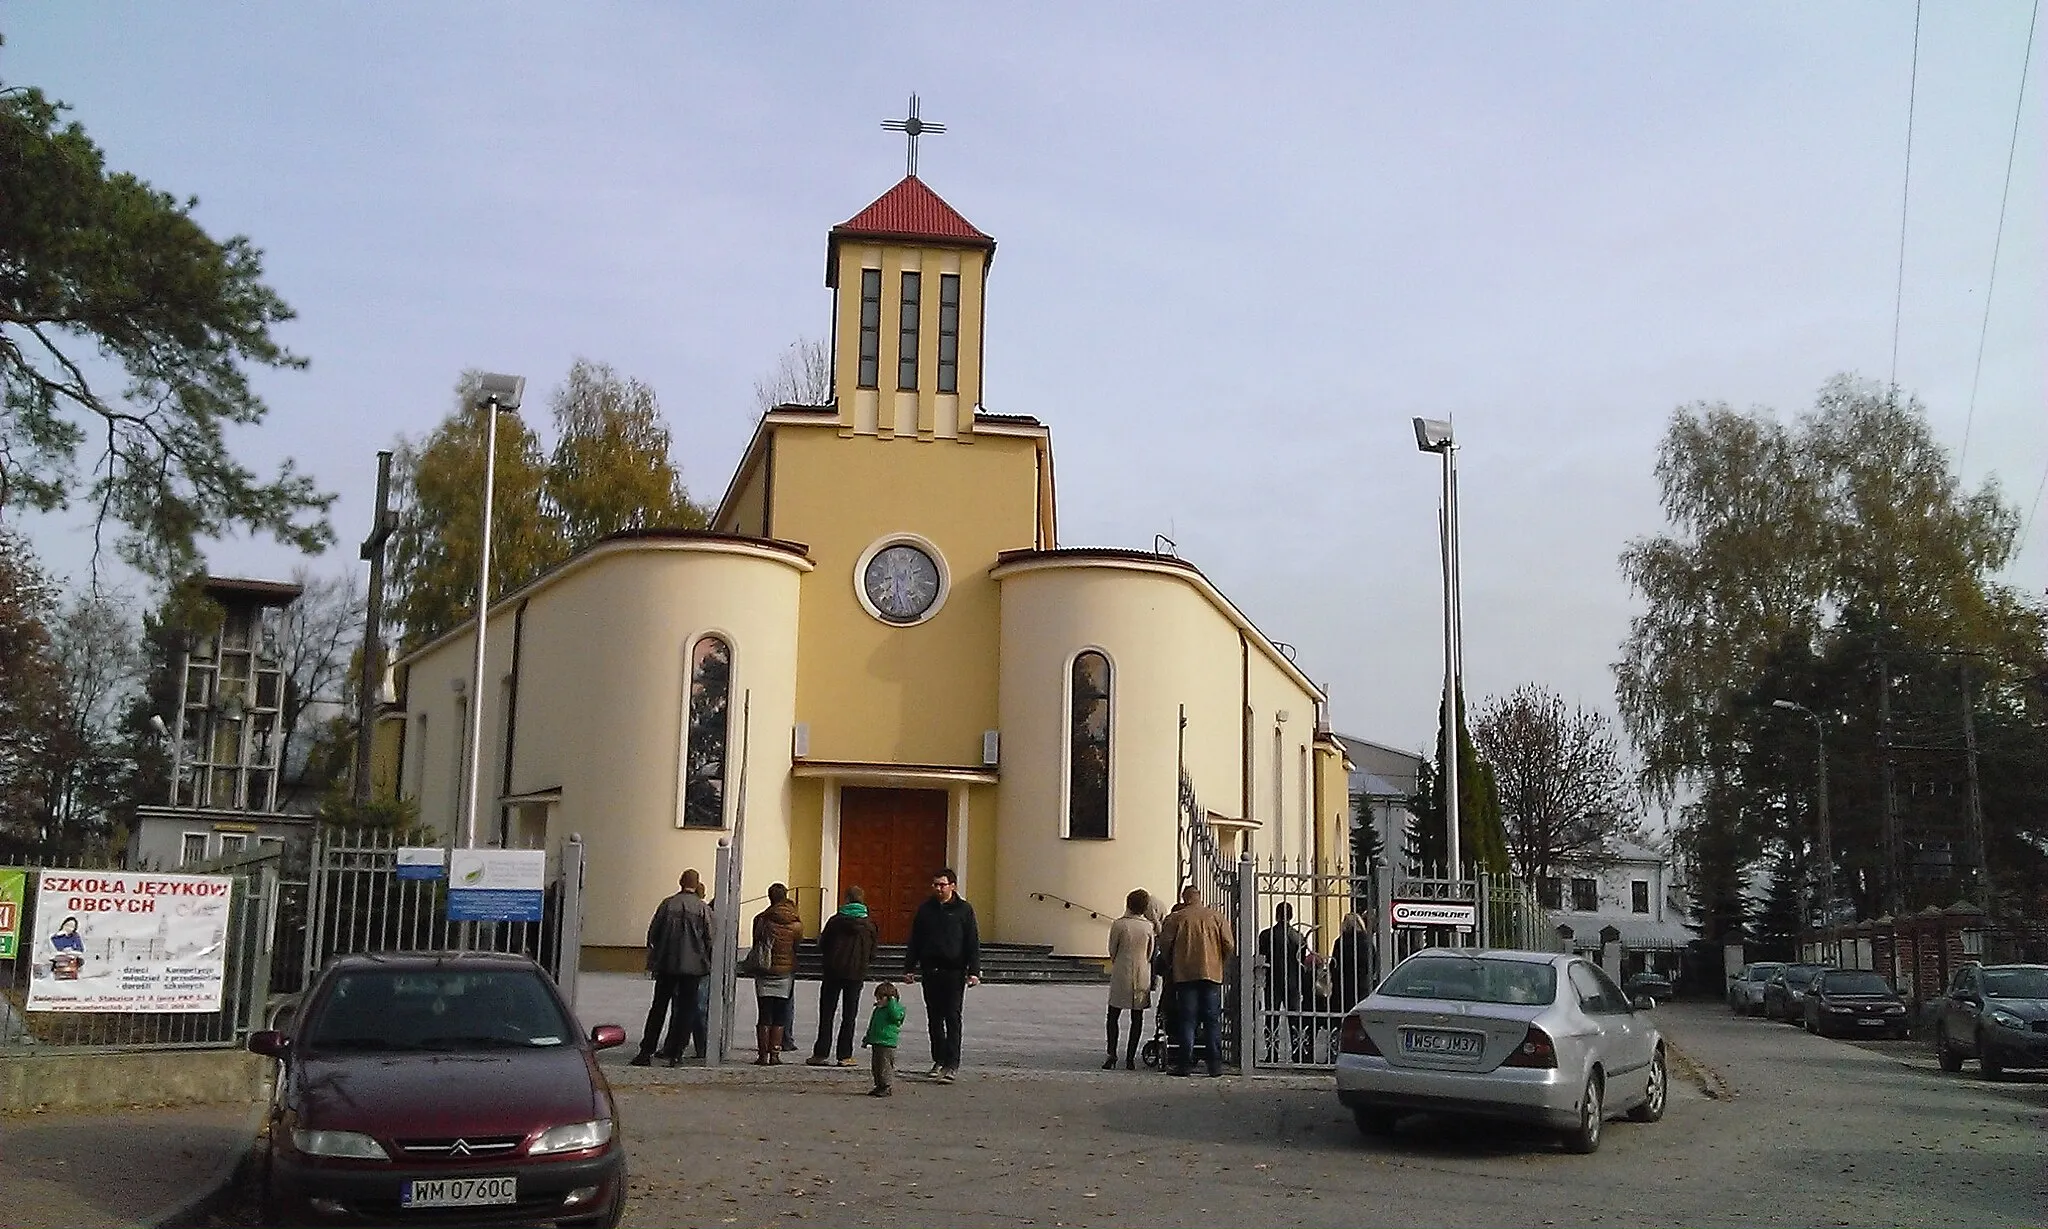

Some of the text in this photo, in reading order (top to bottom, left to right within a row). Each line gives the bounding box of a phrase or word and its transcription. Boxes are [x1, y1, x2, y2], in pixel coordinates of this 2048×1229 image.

[43, 877, 229, 899] SZKOŁA JĘZYKÓW
[67, 897, 156, 913] OBCYCH
[1414, 1034, 1441, 1049] WSC
[416, 1179, 513, 1201] WM 0760C
